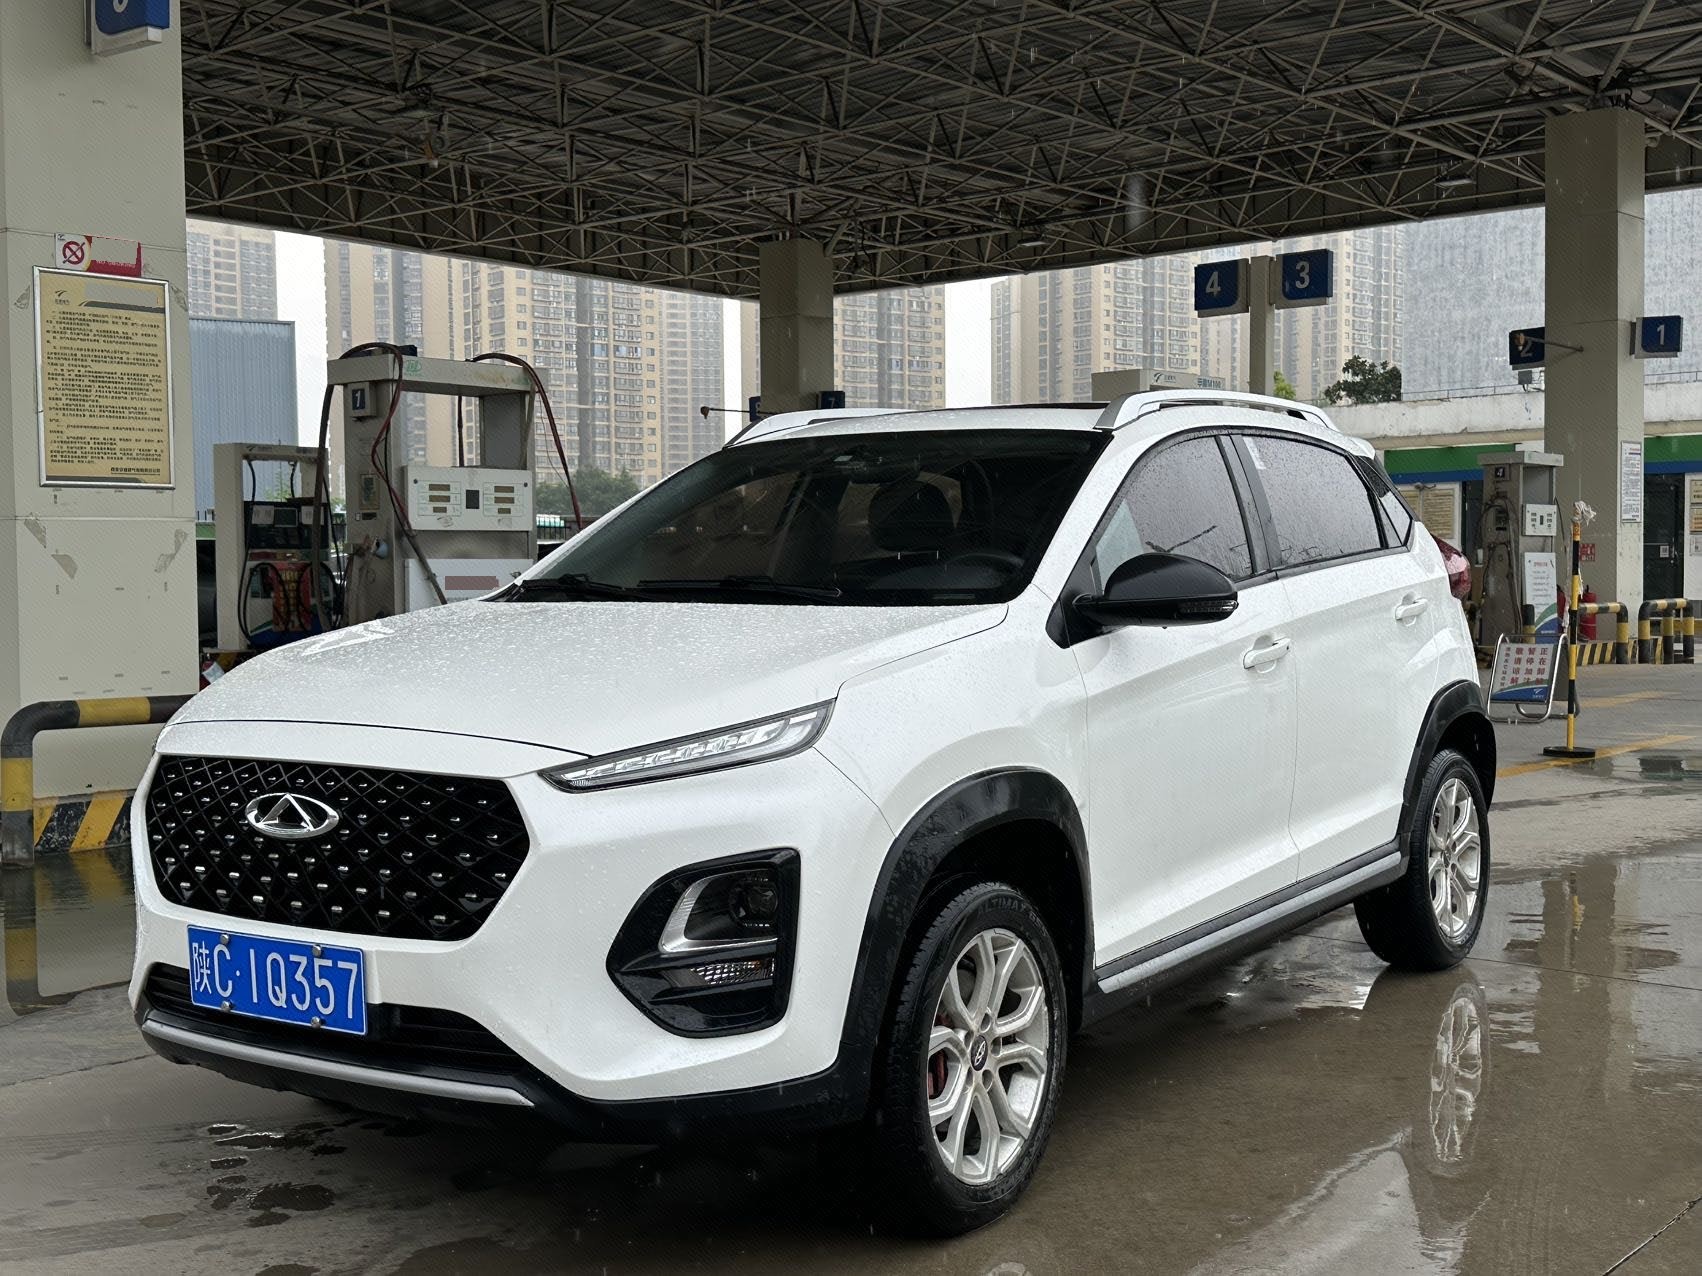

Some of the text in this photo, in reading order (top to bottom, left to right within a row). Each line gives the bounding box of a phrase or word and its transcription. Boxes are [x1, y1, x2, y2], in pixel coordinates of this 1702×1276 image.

[1205, 271, 1221, 296] 4
[1295, 261, 1310, 289] 3
[1656, 324, 1665, 346] 1
[1520, 336, 1533, 358] 2
[355, 390, 361, 408] 1
